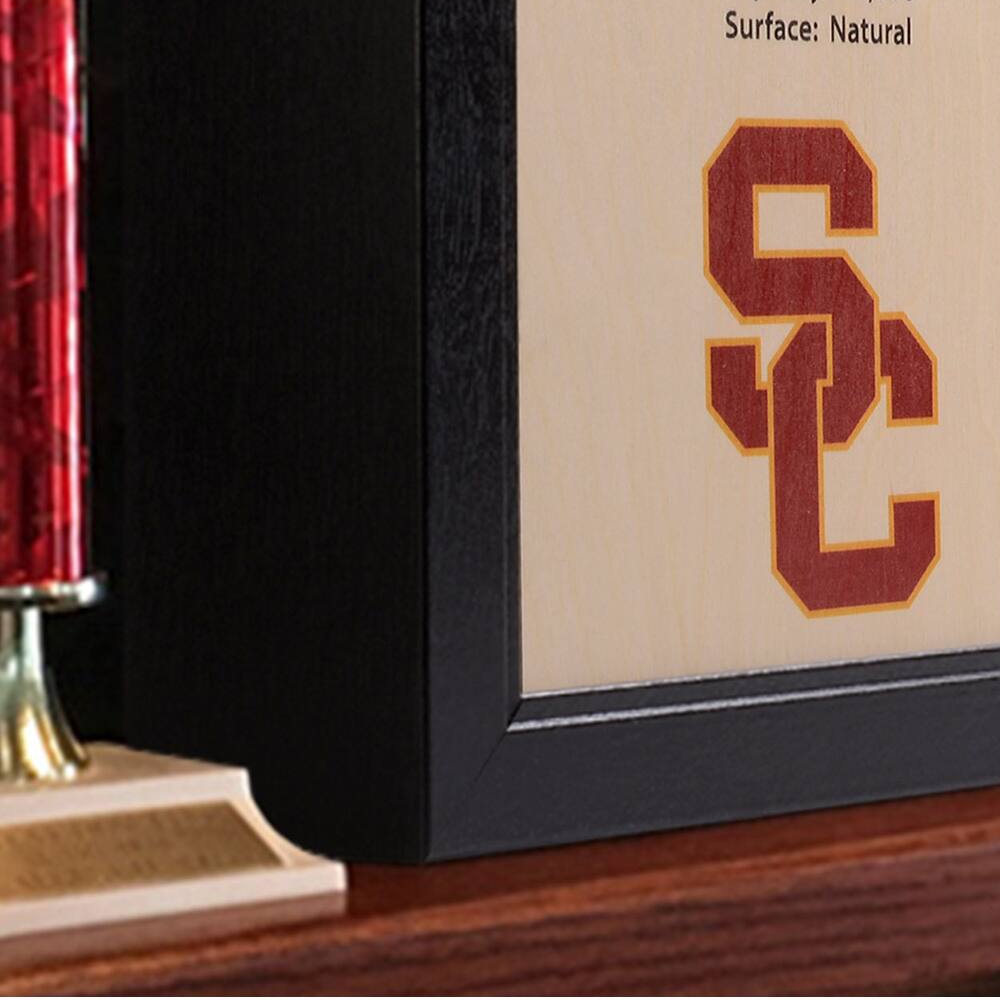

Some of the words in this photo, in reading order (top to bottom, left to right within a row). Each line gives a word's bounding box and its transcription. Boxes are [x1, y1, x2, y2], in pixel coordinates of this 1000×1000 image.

[725, 10, 819, 43] Surface:
[830, 14, 912, 46] Natural
[702, 117, 940, 618] SC
